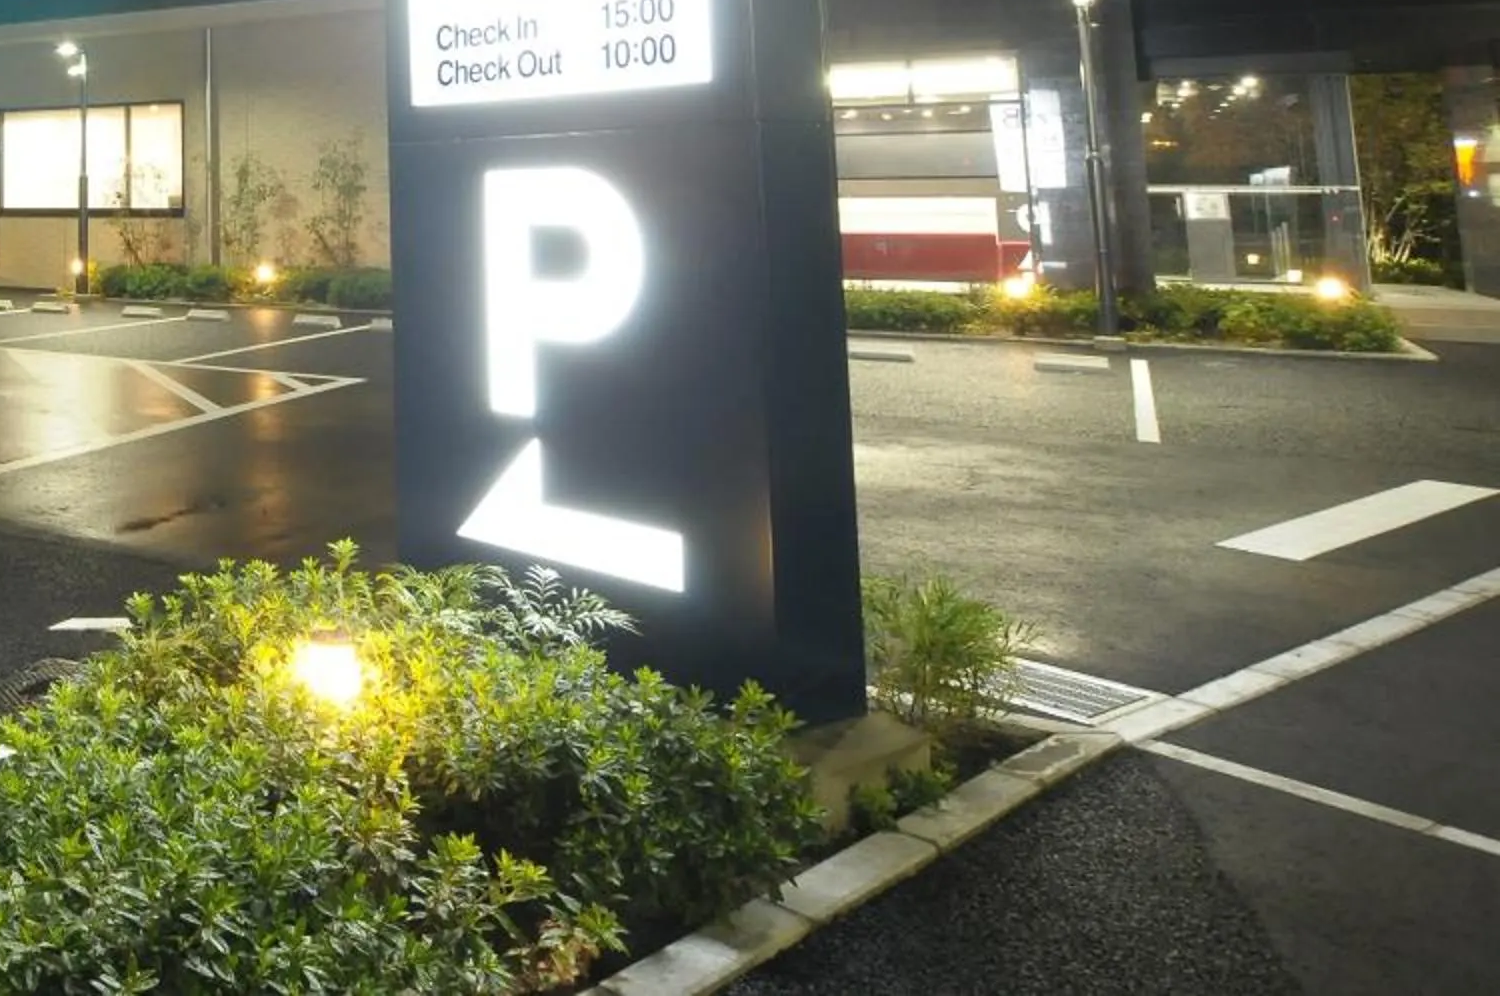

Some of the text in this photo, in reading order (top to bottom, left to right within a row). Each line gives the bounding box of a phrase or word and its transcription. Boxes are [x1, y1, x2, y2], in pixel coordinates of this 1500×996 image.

[436, 18, 510, 50] Check
[517, 16, 538, 40] In
[437, 34, 676, 86] Check Out 10:00
[484, 167, 644, 416] P
